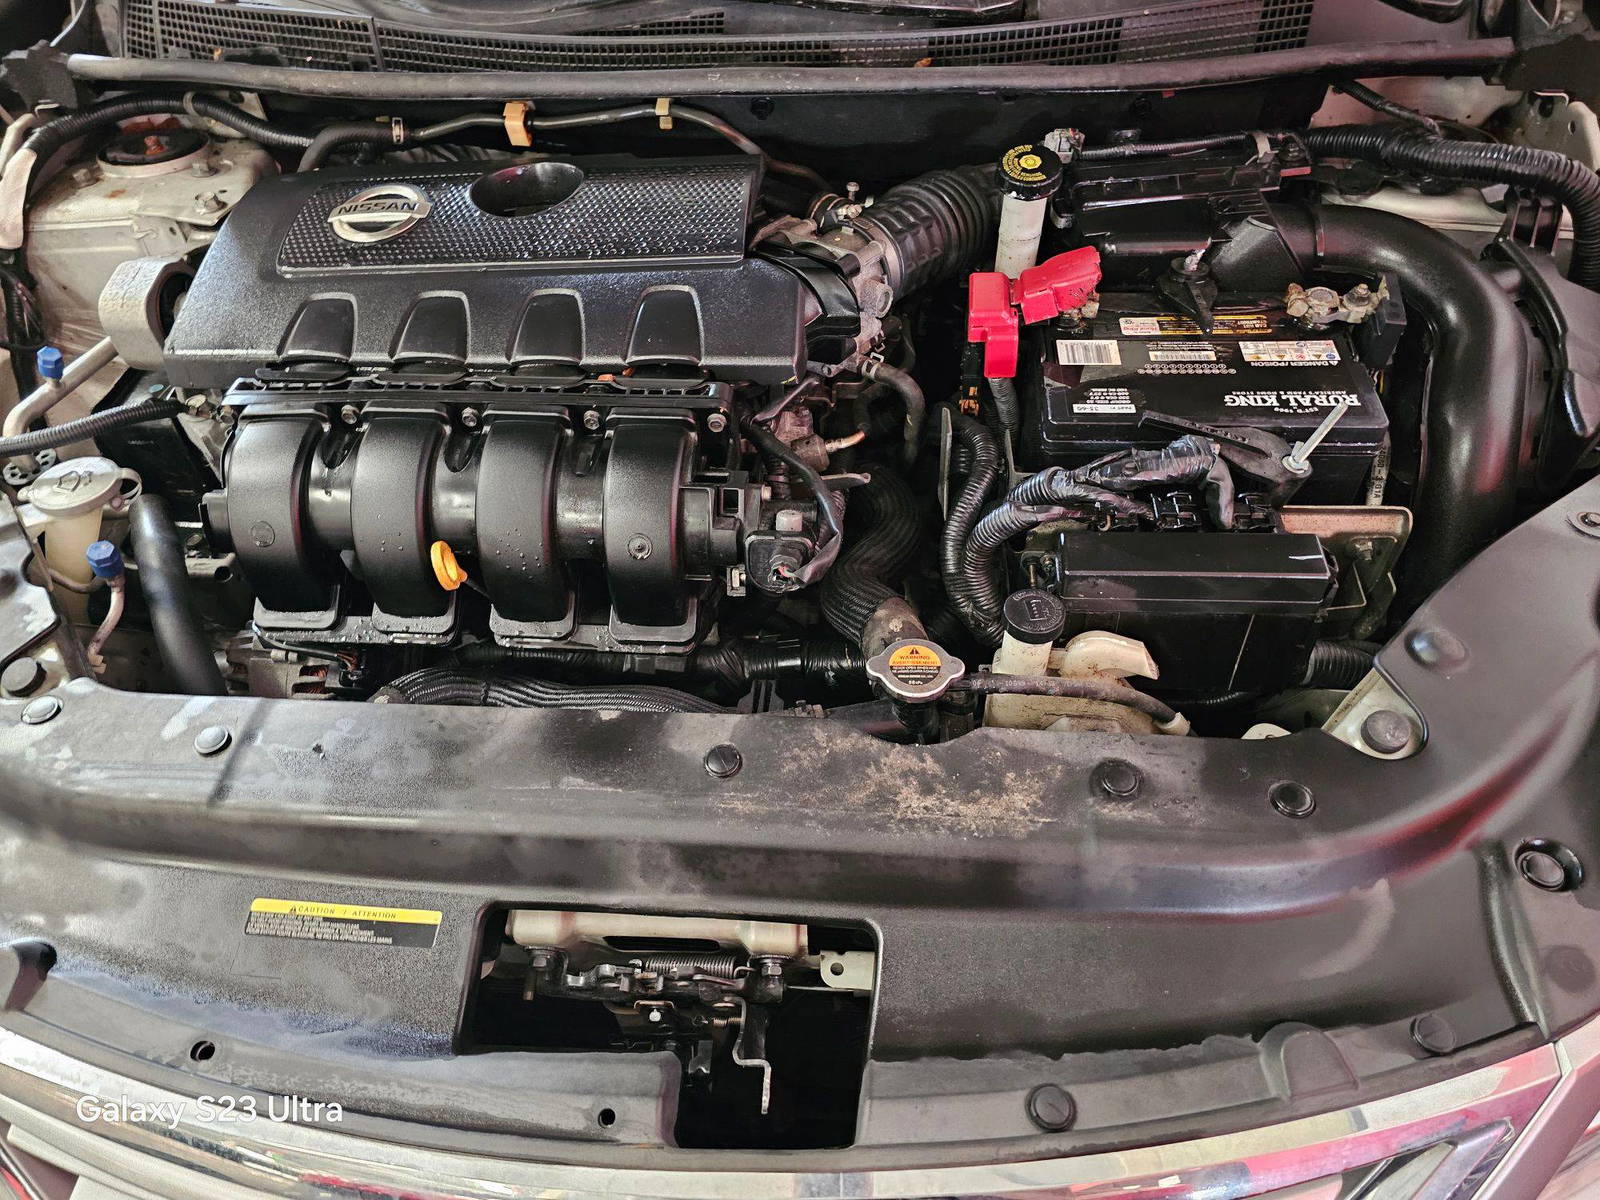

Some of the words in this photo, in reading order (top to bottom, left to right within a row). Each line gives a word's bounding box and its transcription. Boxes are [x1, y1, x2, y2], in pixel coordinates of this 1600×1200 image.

[338, 202, 418, 215] NISSAN
[1223, 394, 1280, 406] KING
[1281, 394, 1361, 407] RURAL
[298, 907, 335, 915] CAUTION
[352, 911, 397, 919] ATTENTION
